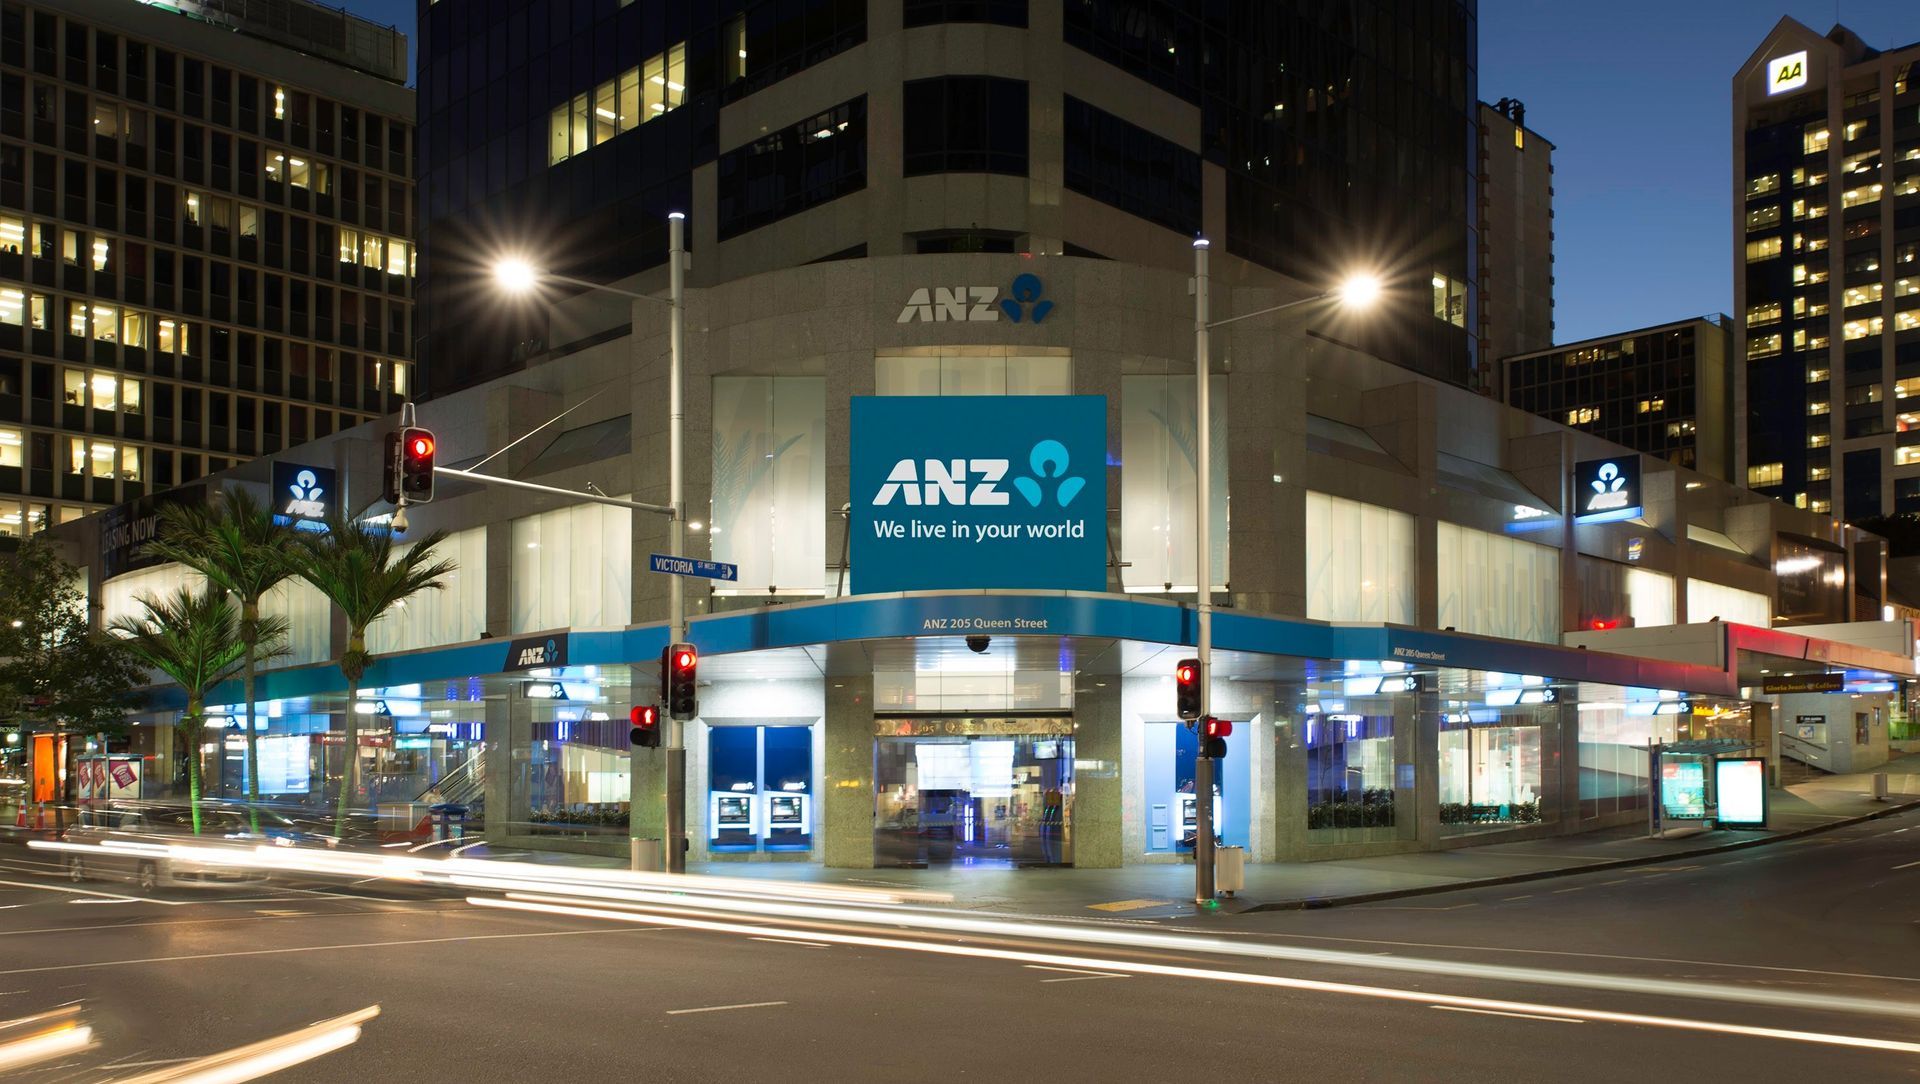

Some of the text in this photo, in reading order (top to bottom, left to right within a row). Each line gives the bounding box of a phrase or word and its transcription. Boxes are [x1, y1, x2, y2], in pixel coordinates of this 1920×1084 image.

[1776, 62, 1802, 83] AA
[897, 286, 999, 323] ANZ
[873, 459, 1010, 506] ANZ
[103, 523, 130, 554] LEASING
[132, 515, 156, 542] NOW
[873, 519, 1085, 544] We live in your world
[655, 557, 694, 575] VICTORIA
[923, 617, 1048, 629] ANZ 205 Queen Street
[518, 646, 545, 666] ANZ
[1415, 649, 1431, 659] Queen
[1431, 652, 1445, 660] Street
